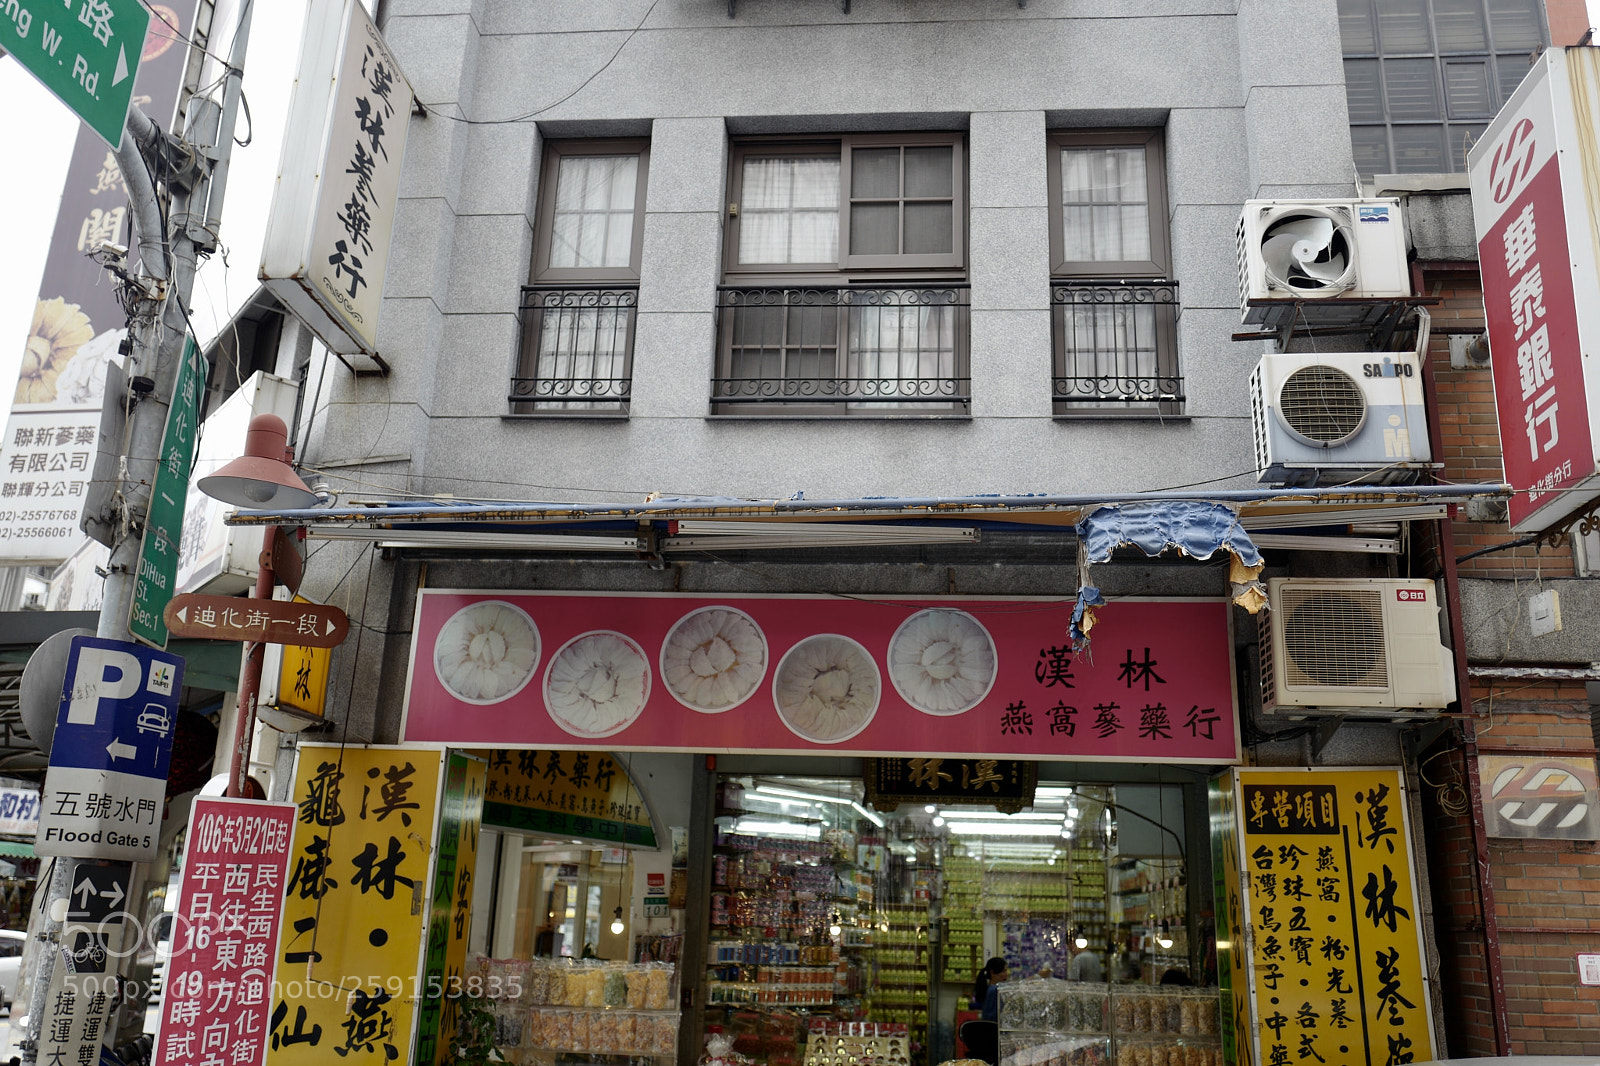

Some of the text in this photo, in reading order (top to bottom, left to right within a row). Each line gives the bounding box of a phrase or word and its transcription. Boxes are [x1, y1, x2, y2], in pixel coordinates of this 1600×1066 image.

[64, 0, 114, 48] 路
[72, 53, 100, 101] Rd.
[1503, 201, 1560, 462] 華泰銀行
[1363, 357, 1413, 378] SAMPO
[8, 452, 89, 473] 有限公司
[154, 376, 196, 557] 迪化街一段
[1, 481, 84, 498] 聯輝分公司
[0, 527, 73, 541] 2)-25566061
[140, 560, 167, 589] DiHua
[136, 582, 149, 603] St.
[133, 603, 159, 632] Sec.1
[194, 605, 320, 637] 迪化街一段
[1035, 645, 1166, 691] 漢林
[67, 646, 142, 725] P
[152, 679, 169, 690] TAIPEI
[0, 791, 41, 820] 和村
[50, 791, 156, 826] 五號水門
[1250, 789, 1336, 830] 專營項目
[45, 828, 151, 849] Flood Gate 5
[197, 813, 288, 855] 106年3月21日起
[646, 905, 668, 916] 101
[47, 990, 76, 1066] 捷運大
